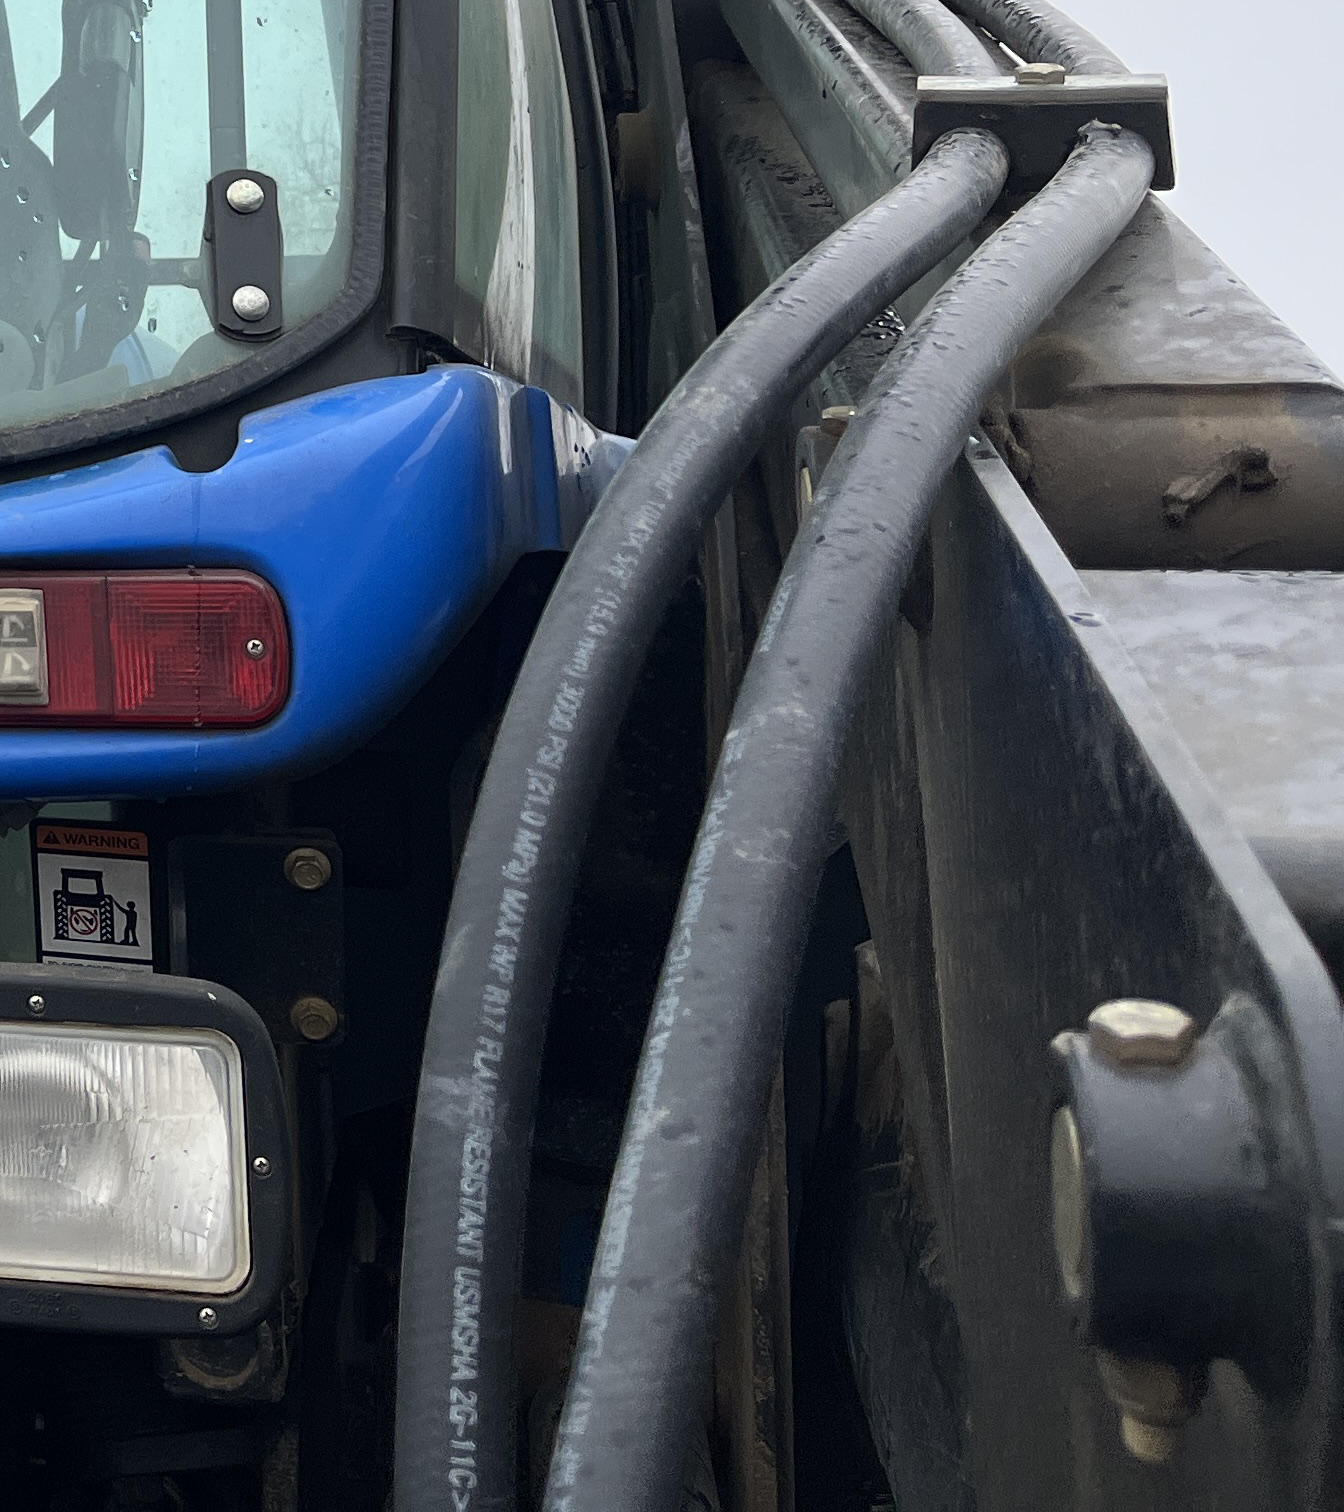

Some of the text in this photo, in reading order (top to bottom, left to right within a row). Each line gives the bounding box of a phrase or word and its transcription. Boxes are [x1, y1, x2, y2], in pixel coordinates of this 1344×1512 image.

[536, 733, 568, 771] PSI
[63, 833, 141, 851] WARNING
[494, 887, 529, 943] MAX
[456, 1122, 493, 1263] RESISTANT
